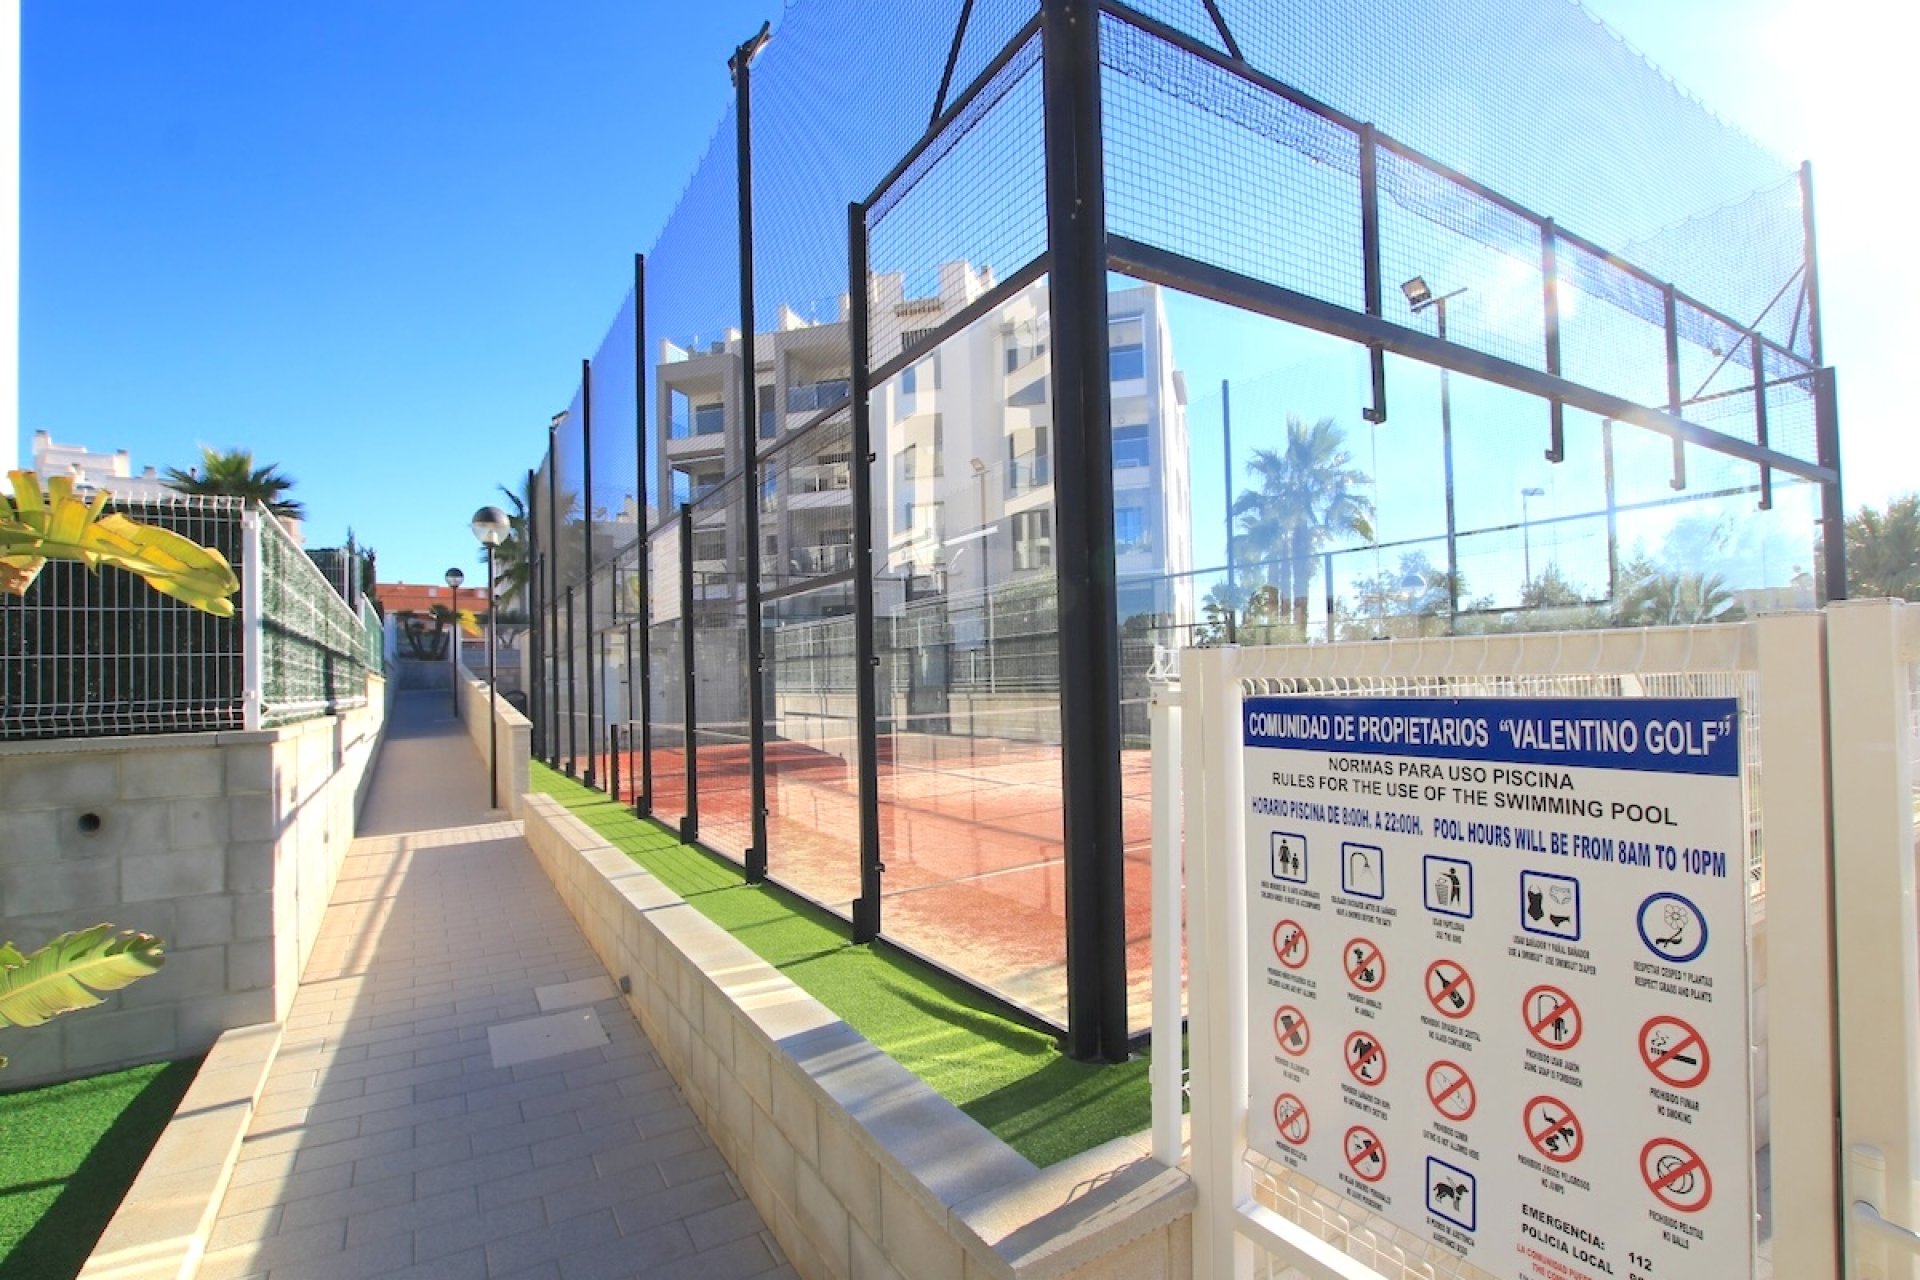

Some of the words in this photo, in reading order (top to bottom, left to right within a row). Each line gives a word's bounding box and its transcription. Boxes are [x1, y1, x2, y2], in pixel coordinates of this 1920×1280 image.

[1249, 712, 1330, 741] COMUNIDAD
[1334, 715, 1354, 742] DE
[1359, 716, 1489, 748] PROPIETARIOS
[1329, 757, 1393, 776] NORMAS
[1399, 762, 1443, 780] PARA
[1449, 766, 1487, 784] USO
[1493, 768, 1574, 790] PISCINA
[1272, 772, 1315, 789] RULES
[1320, 777, 1348, 792] FOR
[1353, 779, 1382, 795] THE
[1387, 783, 1418, 800] USE
[1424, 785, 1447, 801] OF
[1453, 788, 1488, 807] THE
[1494, 791, 1603, 818] SWIMMING
[1611, 802, 1678, 826] POOL
[1252, 797, 1288, 817] HORARIO
[1291, 801, 1325, 822] PISCINA
[1328, 805, 1340, 824] DE
[1375, 811, 1382, 830] A
[1434, 818, 1465, 842] POOL
[1468, 821, 1511, 848] HOURS
[1514, 827, 1546, 853] WILL
[1551, 832, 1568, 856] BE
[1573, 835, 1613, 862] FROM
[1618, 840, 1650, 867] 8AM
[1656, 844, 1677, 871] TO
[1683, 847, 1726, 878] 10PM
[1522, 1203, 1606, 1250] EMERGENCIA:
[1522, 1223, 1569, 1254] POLICIA
[1573, 1245, 1614, 1275] LOCAL
[1628, 1252, 1652, 1272] 112
